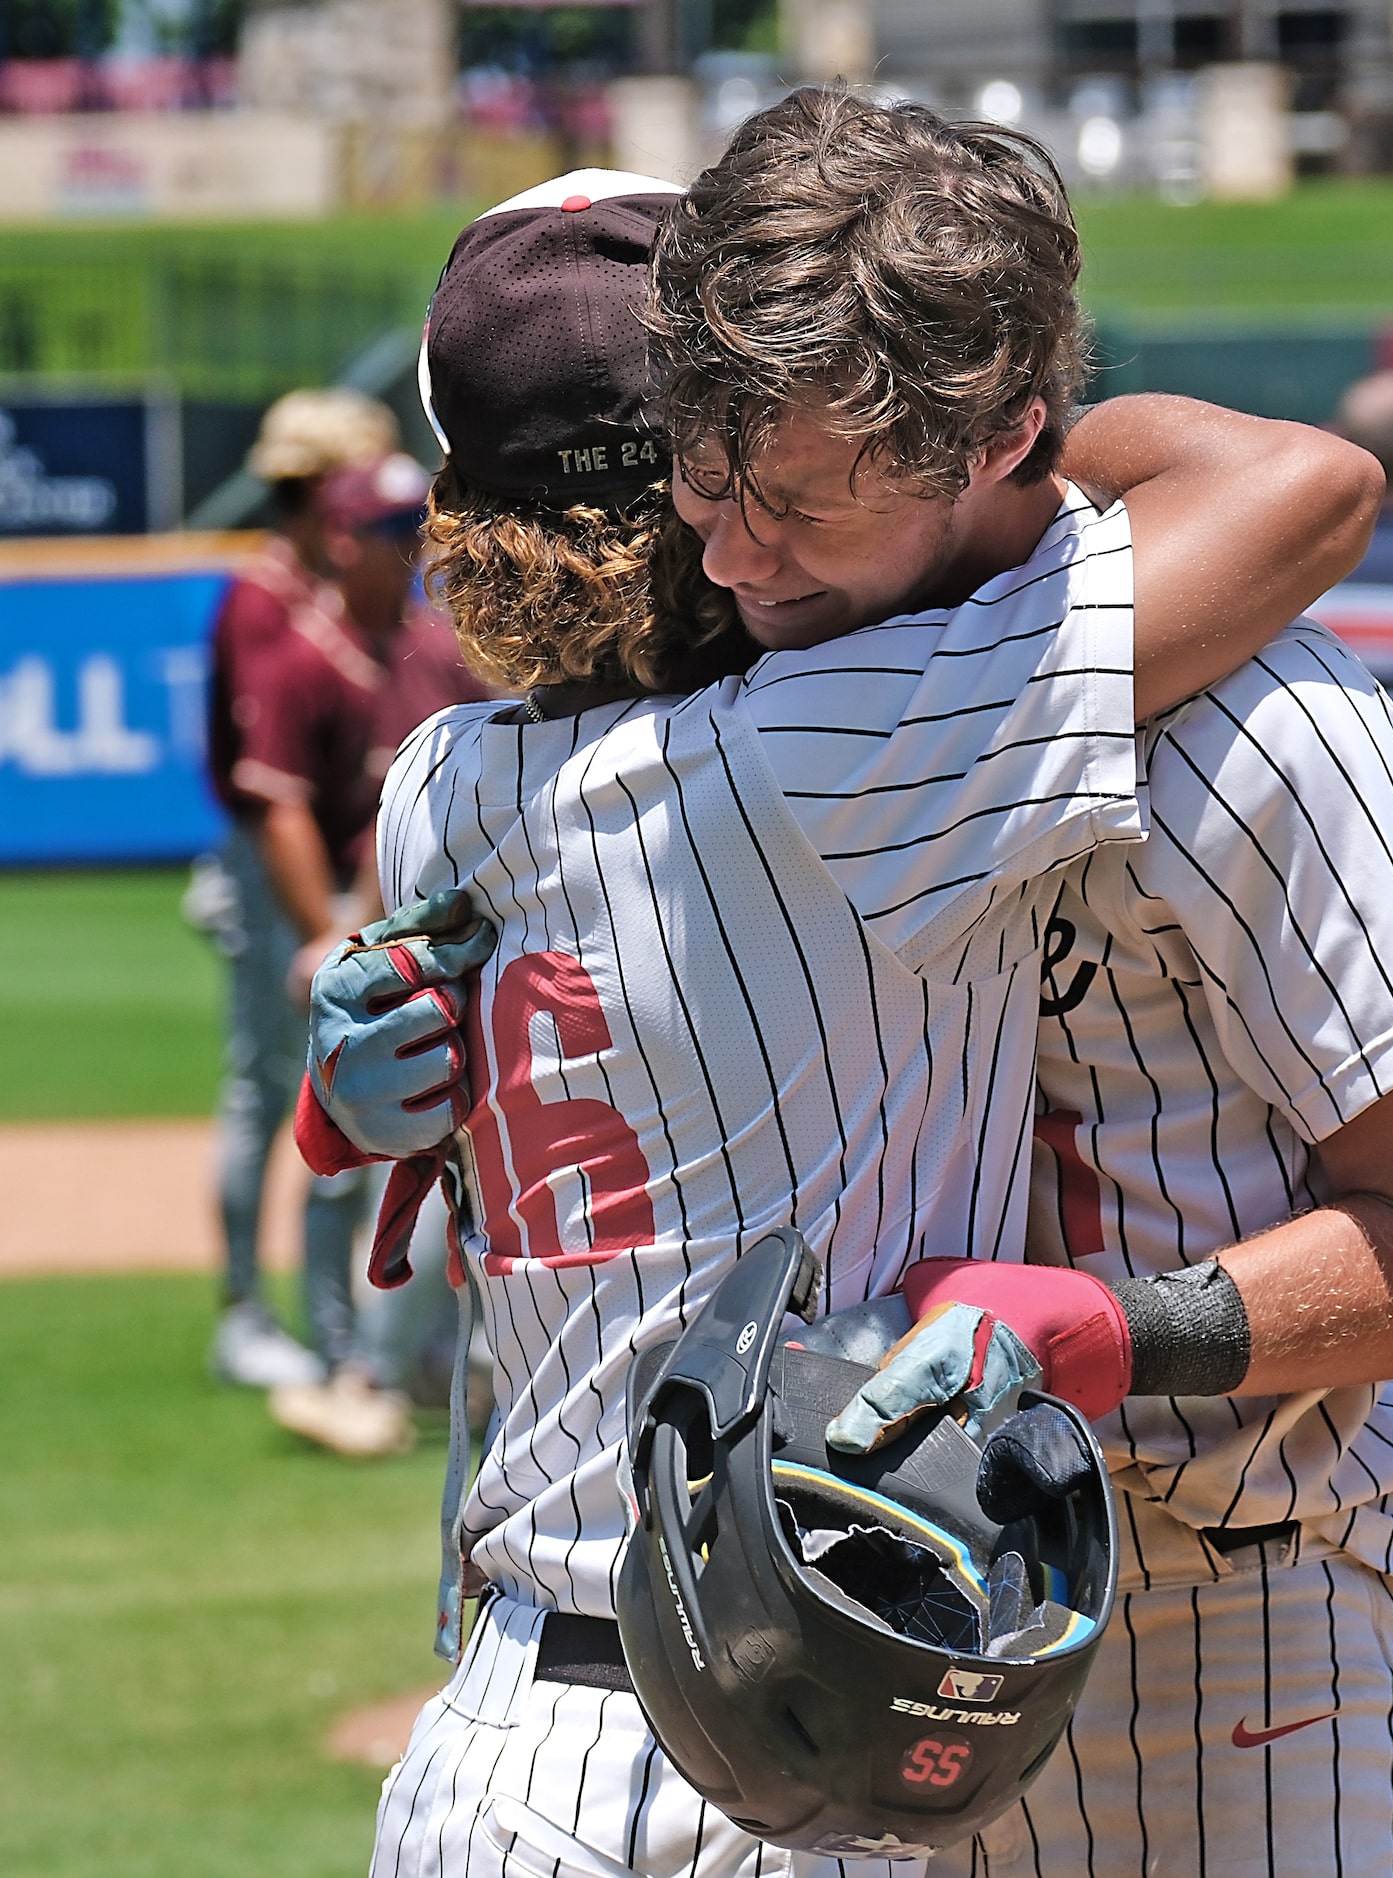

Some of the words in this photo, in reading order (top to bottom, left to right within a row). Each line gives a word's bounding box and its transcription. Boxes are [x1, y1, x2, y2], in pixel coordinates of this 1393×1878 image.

[557, 446, 609, 474] THE
[620, 440, 658, 467] 24
[889, 1697, 1022, 1727] RAWLINGS
